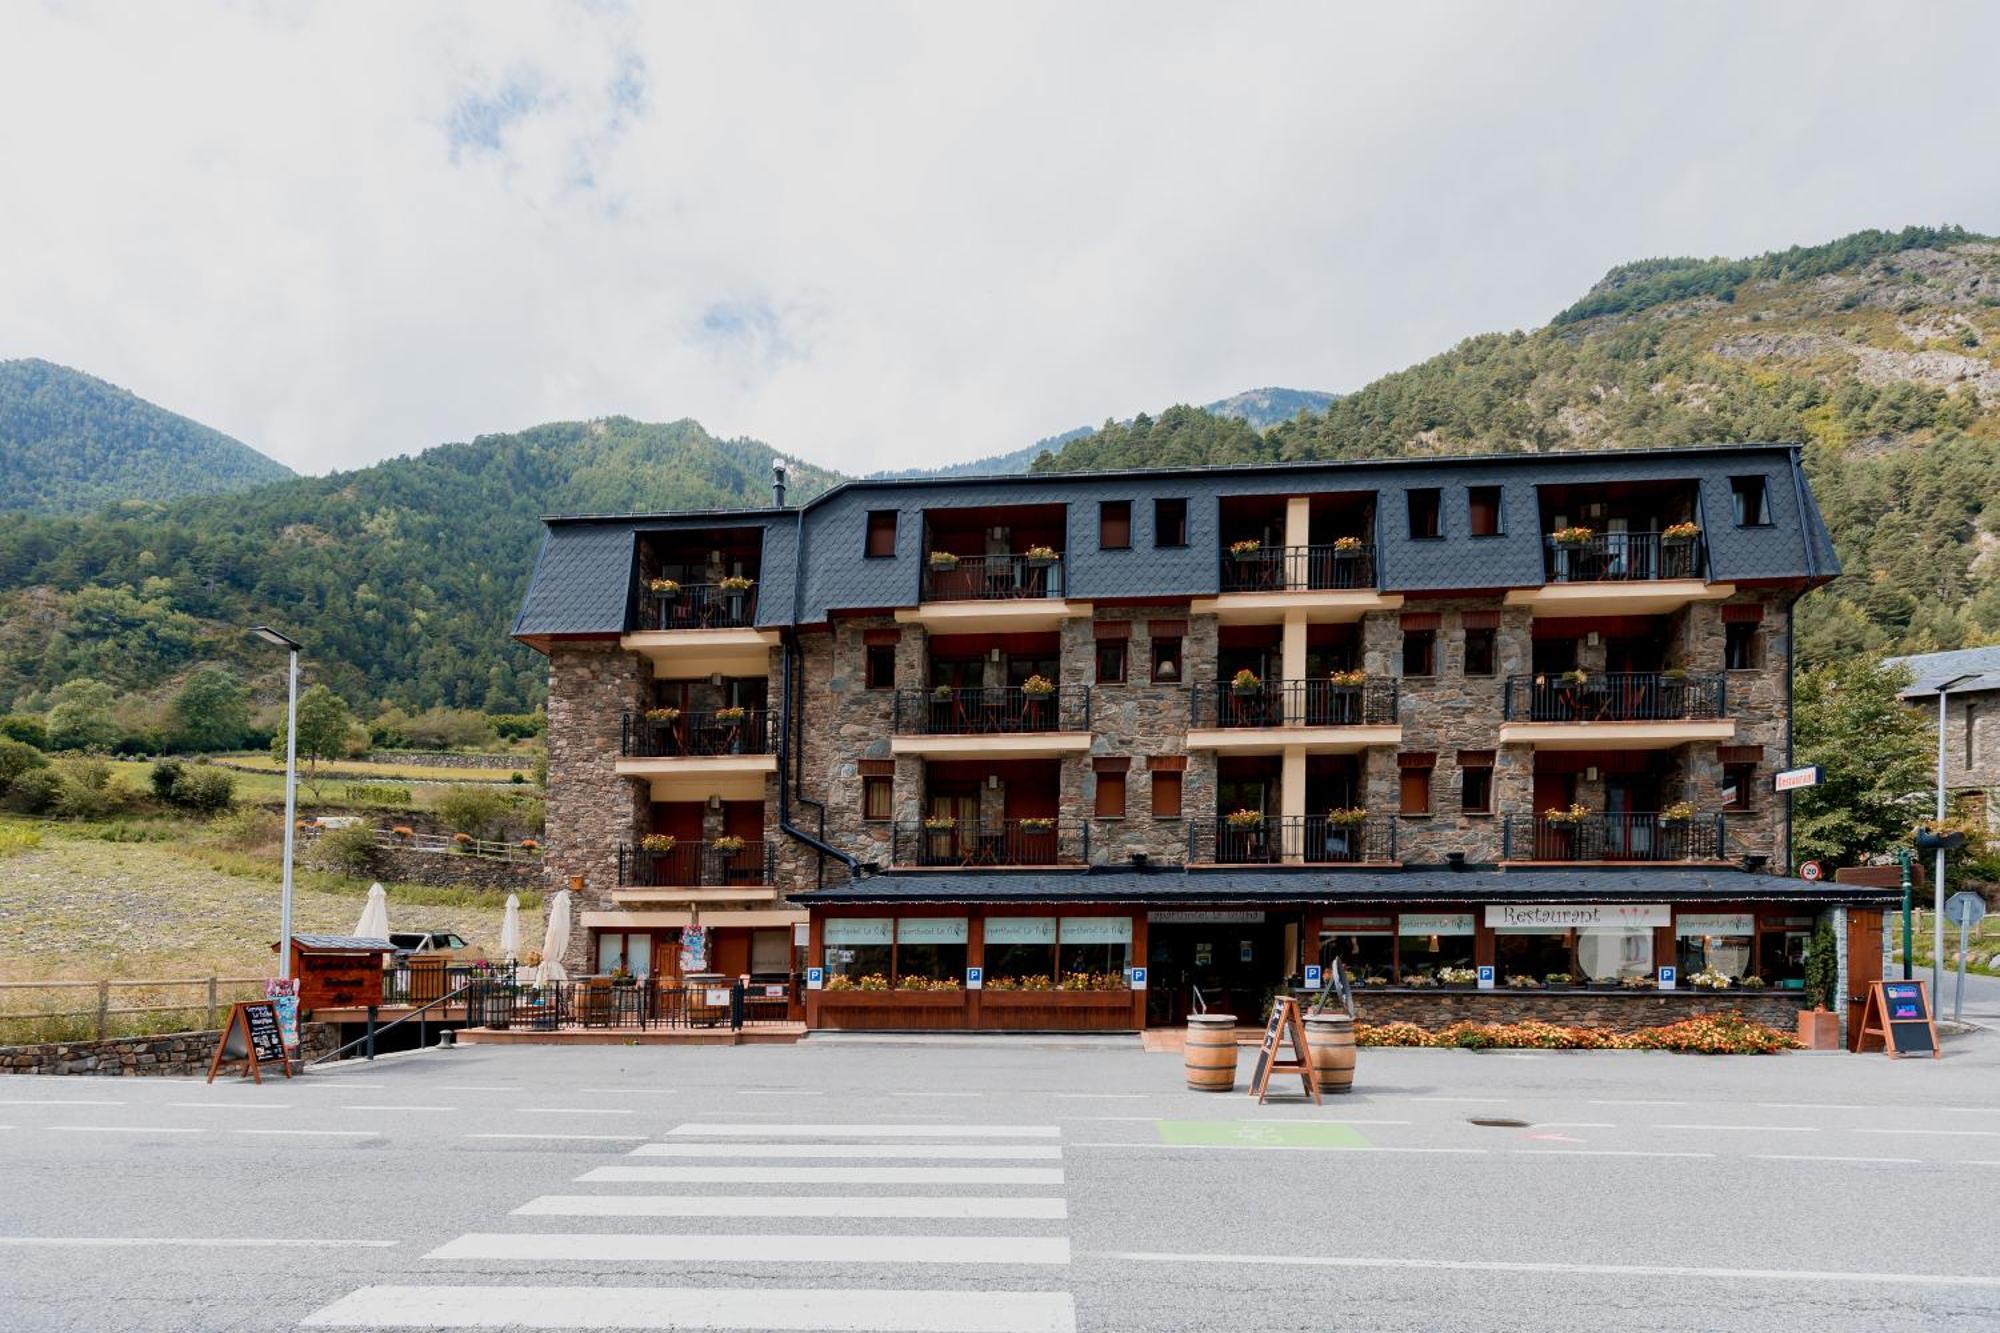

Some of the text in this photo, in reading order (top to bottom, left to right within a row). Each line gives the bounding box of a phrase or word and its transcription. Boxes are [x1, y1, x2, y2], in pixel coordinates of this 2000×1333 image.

[1503, 906, 1601, 925] Restaurant
[811, 971, 819, 979] P
[970, 971, 978, 979] P
[1135, 971, 1143, 979] P
[1309, 969, 1317, 977] P
[1482, 970, 1490, 978] P
[1663, 971, 1671, 979] P
